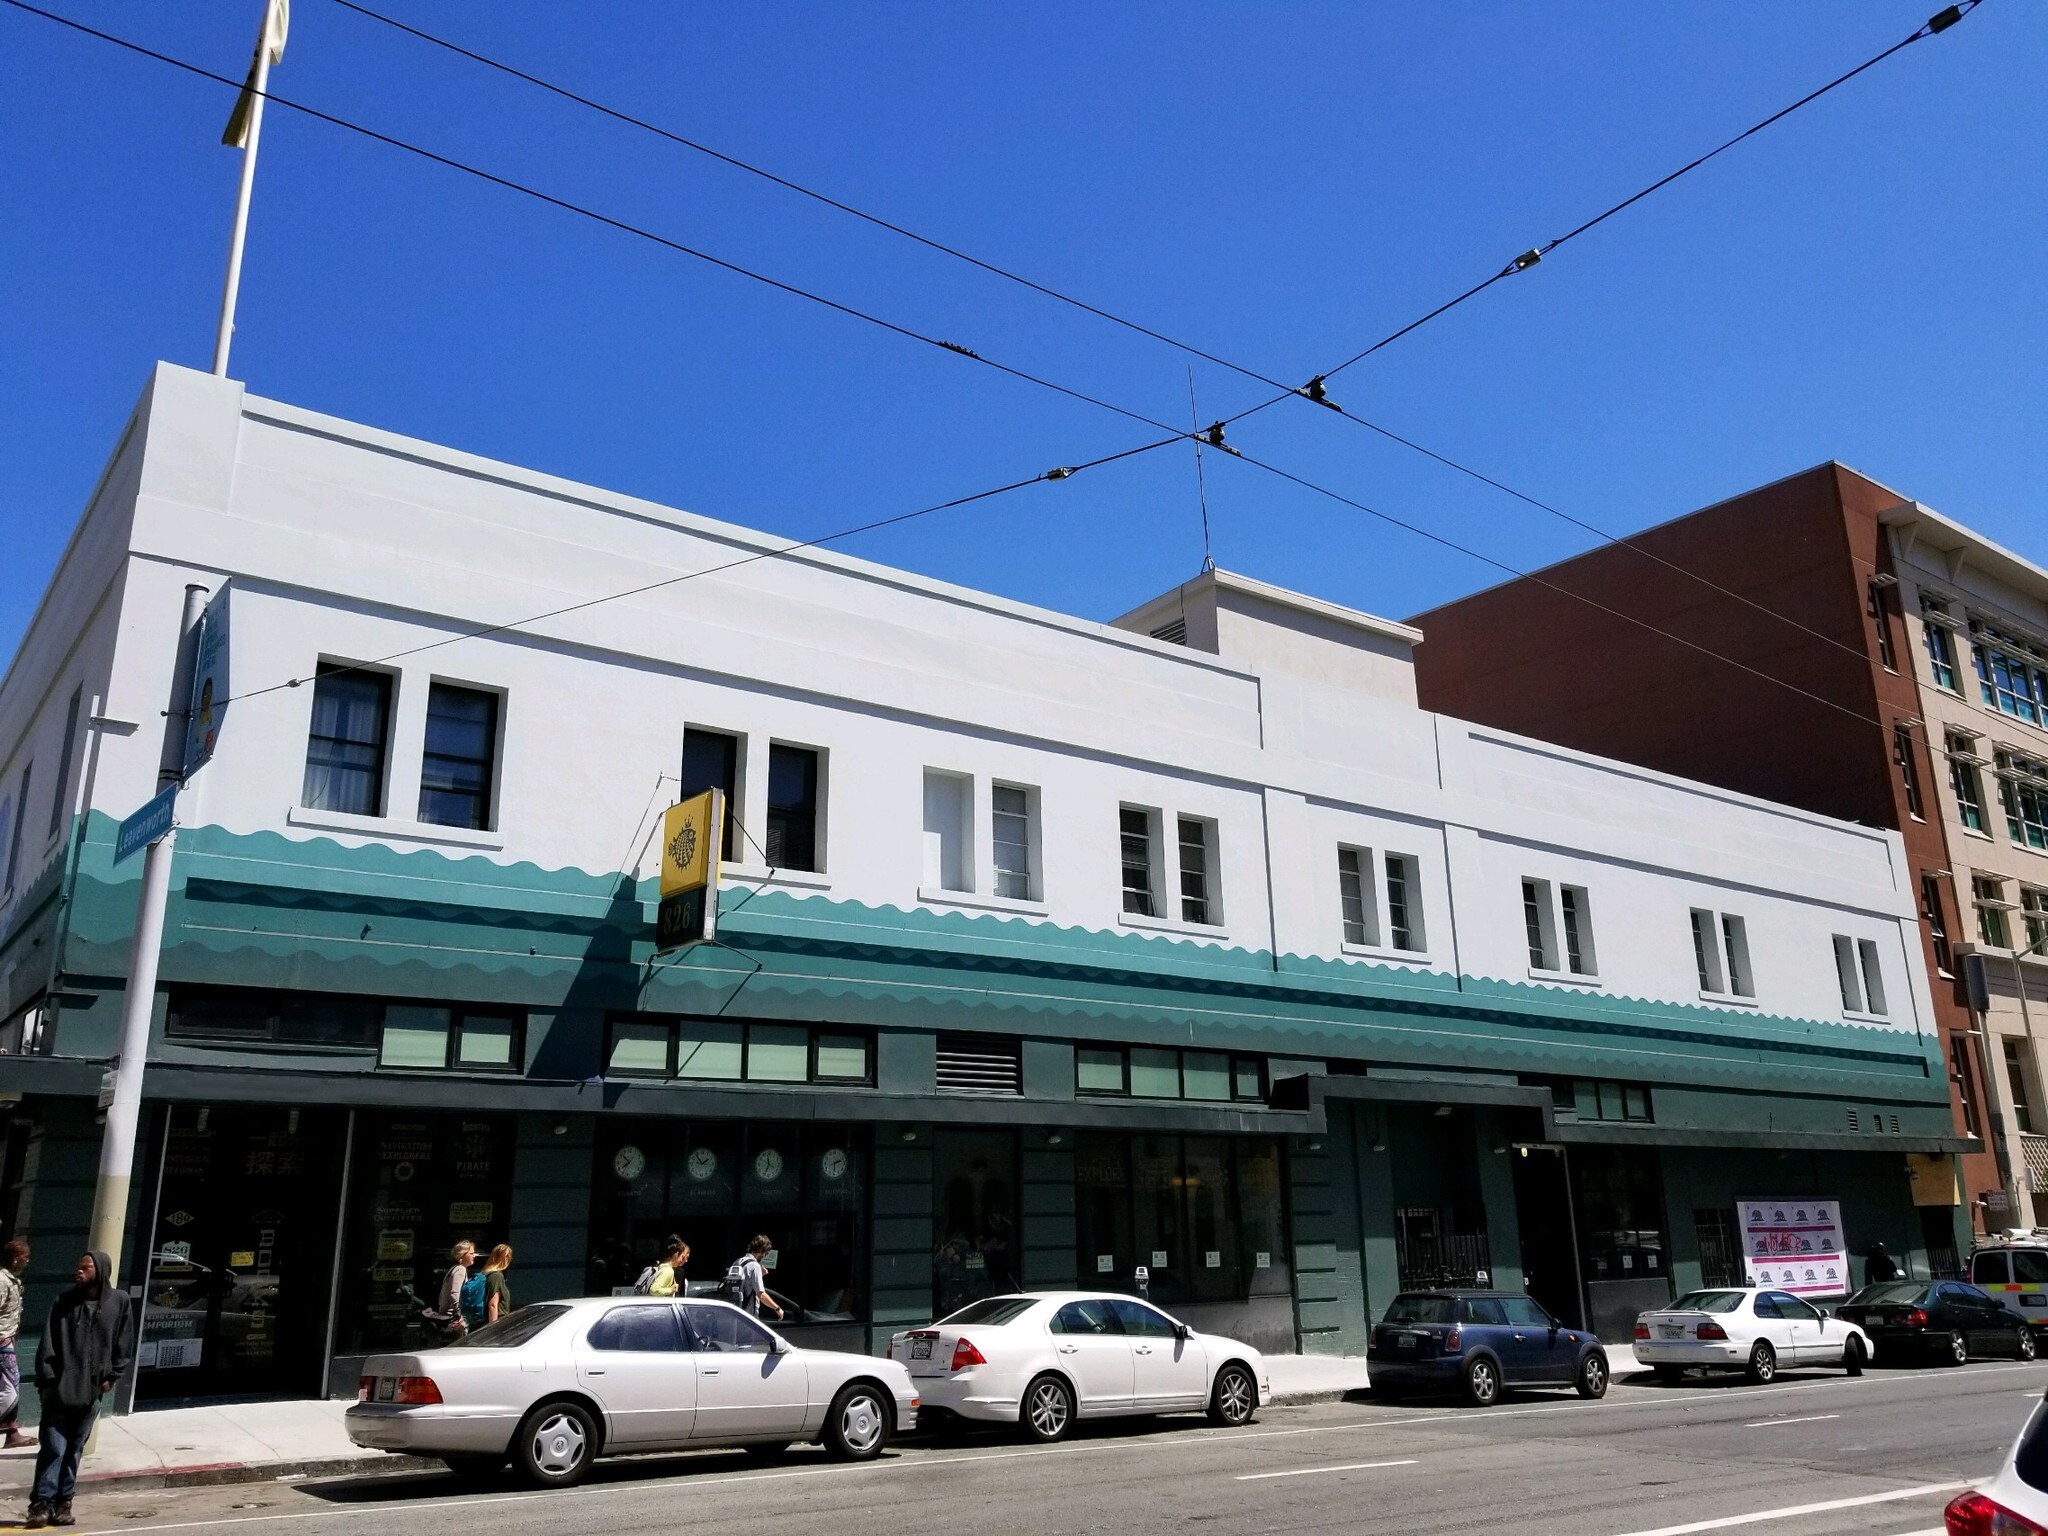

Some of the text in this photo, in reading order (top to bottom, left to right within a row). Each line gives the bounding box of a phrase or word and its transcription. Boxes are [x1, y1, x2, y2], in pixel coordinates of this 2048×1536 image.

[117, 800, 170, 854] Leavenworth
[664, 902, 691, 935] 826
[382, 1151, 431, 1160] EXPLORERS
[456, 1161, 491, 1171] PIRATE
[1077, 1166, 1126, 1182] EXPLORE
